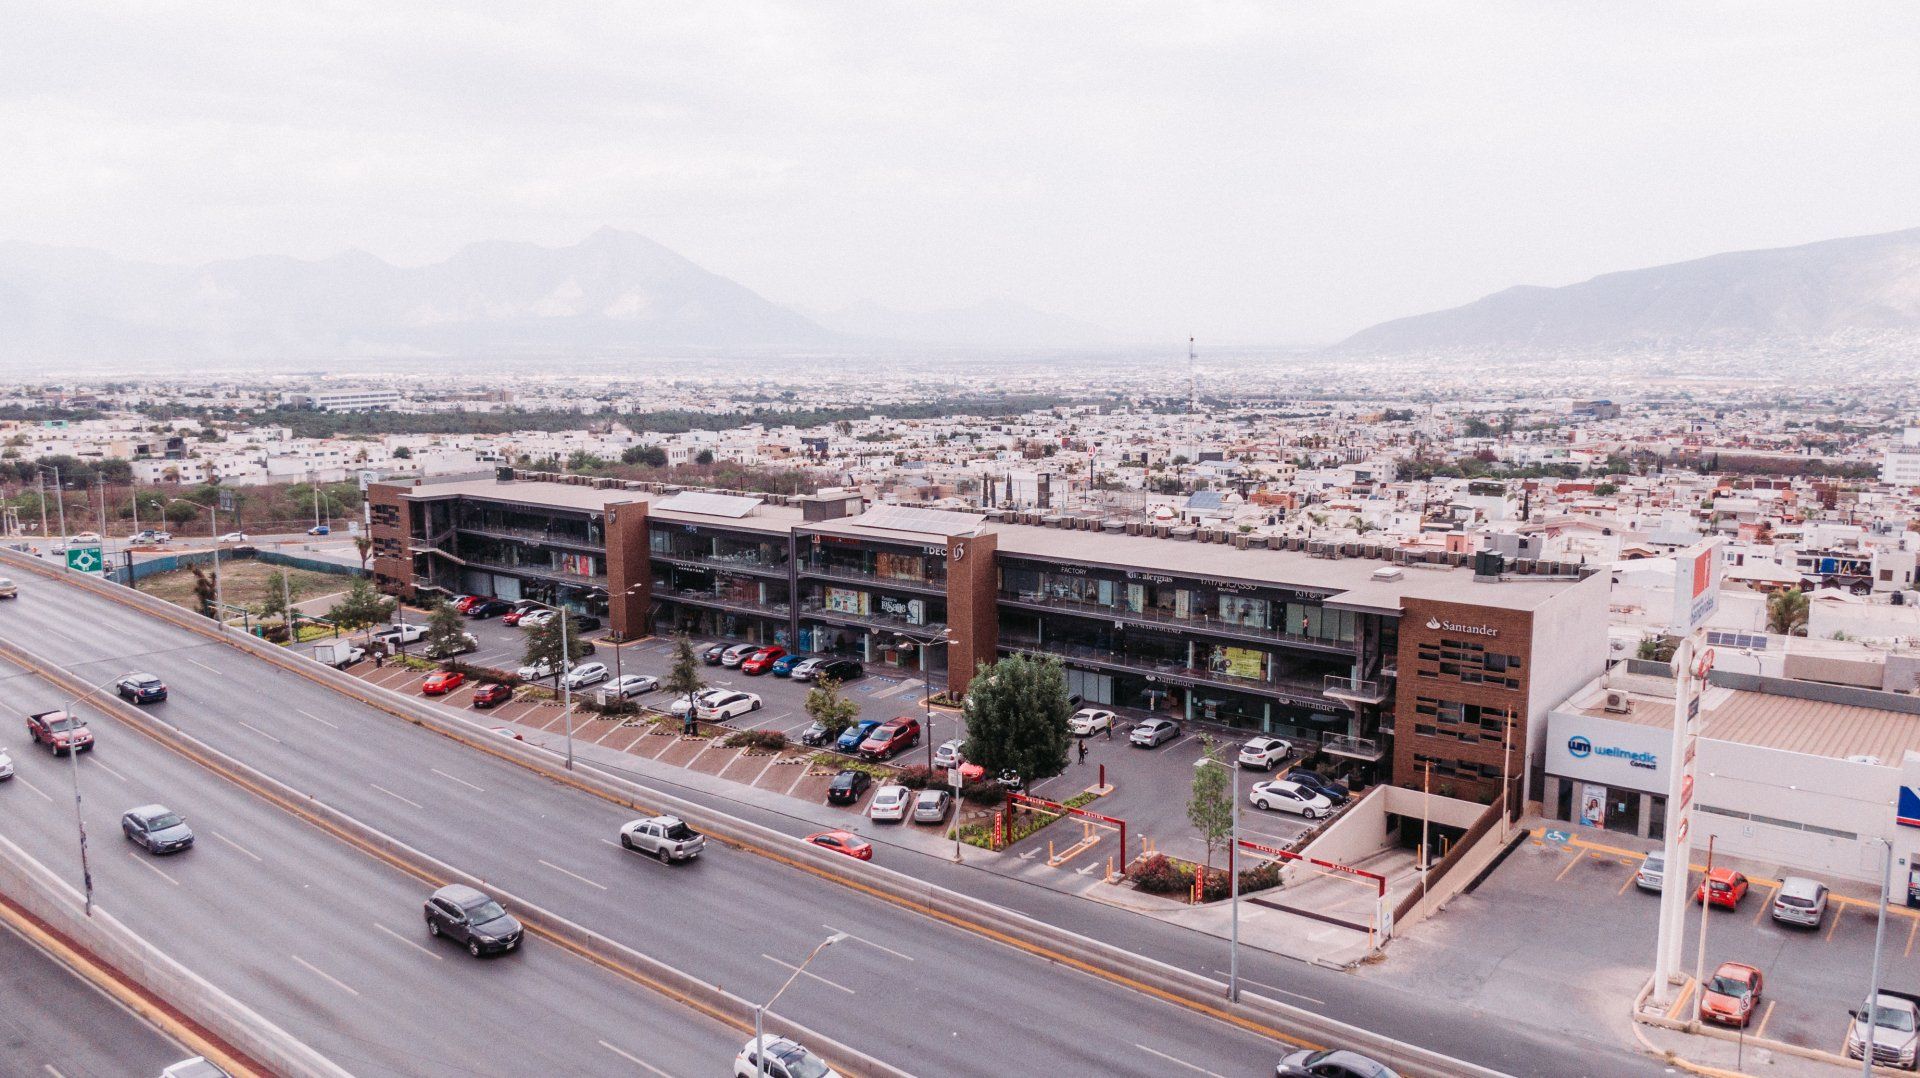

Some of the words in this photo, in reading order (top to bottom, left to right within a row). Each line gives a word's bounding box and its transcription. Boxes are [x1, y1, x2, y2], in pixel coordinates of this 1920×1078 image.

[1061, 566, 1088, 575] FACTORY
[1142, 573, 1173, 584] alergias
[1442, 620, 1498, 637] Santander
[1157, 676, 1195, 688] Santander
[1292, 700, 1336, 712] Santander
[1594, 746, 1657, 763] wellmedic
[1630, 760, 1657, 770] Connect
[1083, 811, 1104, 820] SALIDA
[1256, 845, 1280, 855] SALIDA
[1332, 864, 1358, 873] SALIDA
